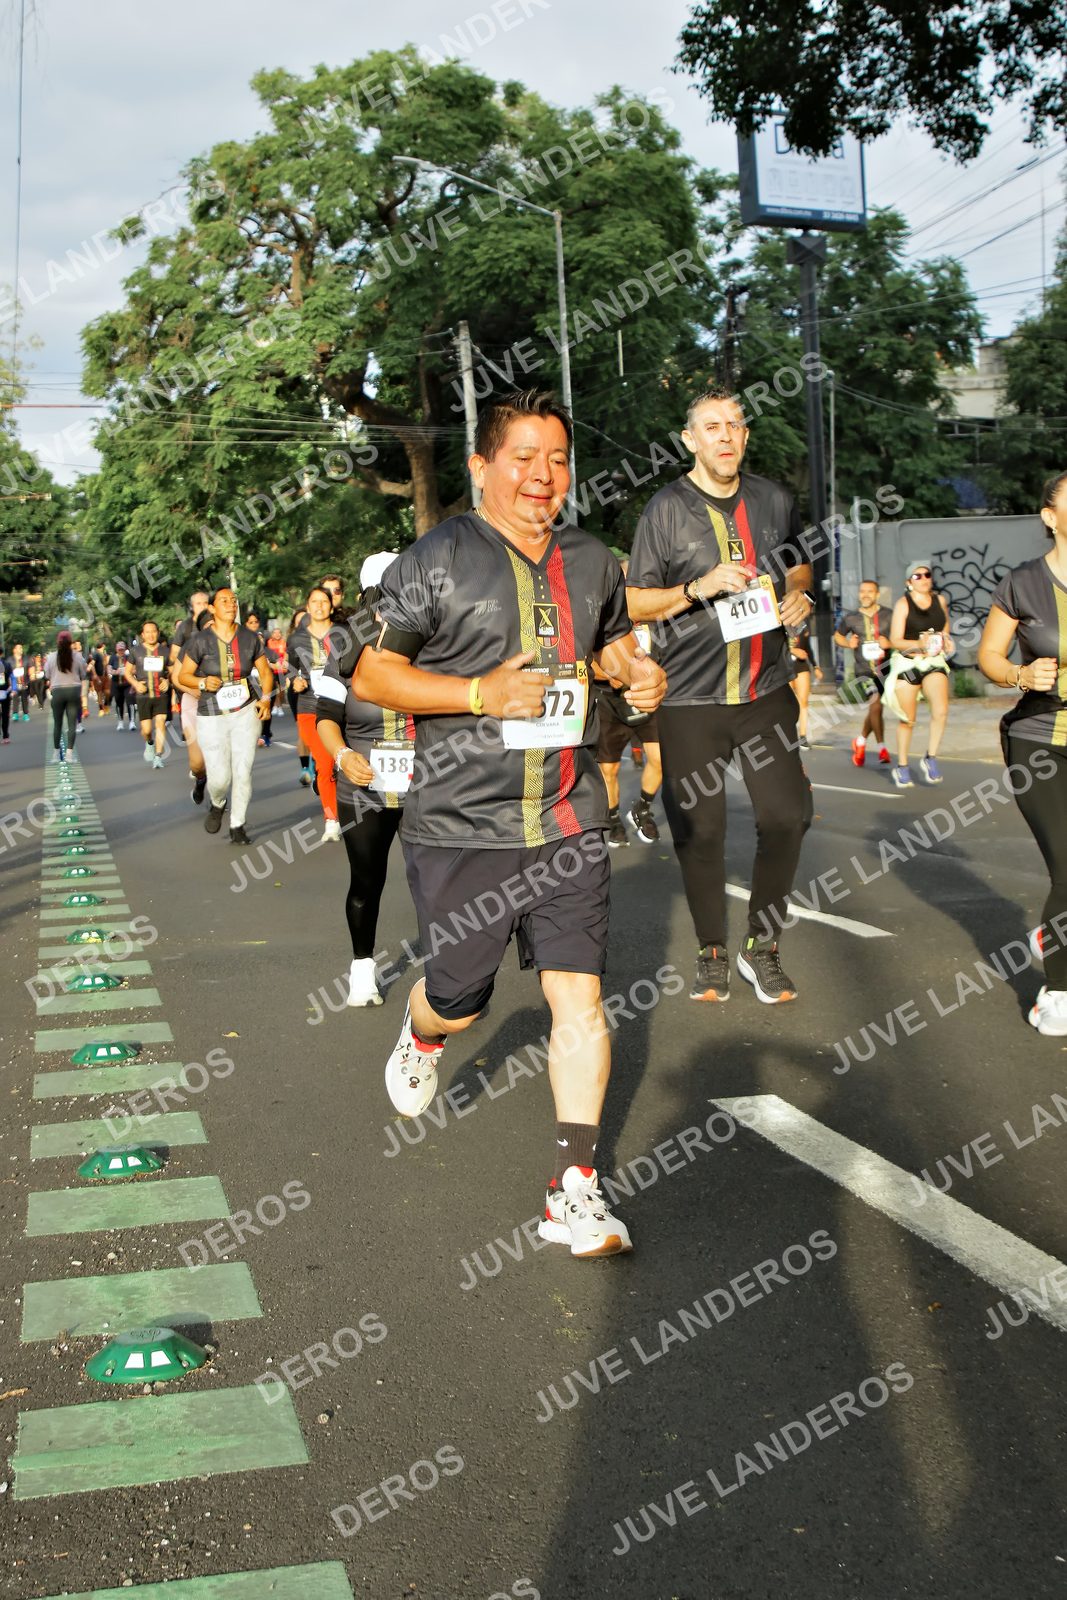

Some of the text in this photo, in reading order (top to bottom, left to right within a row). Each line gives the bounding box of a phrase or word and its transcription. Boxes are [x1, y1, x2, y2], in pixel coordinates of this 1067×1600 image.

[931, 543, 989, 565] TOY
[730, 598, 759, 619] 410
[377, 757, 413, 773] 138
